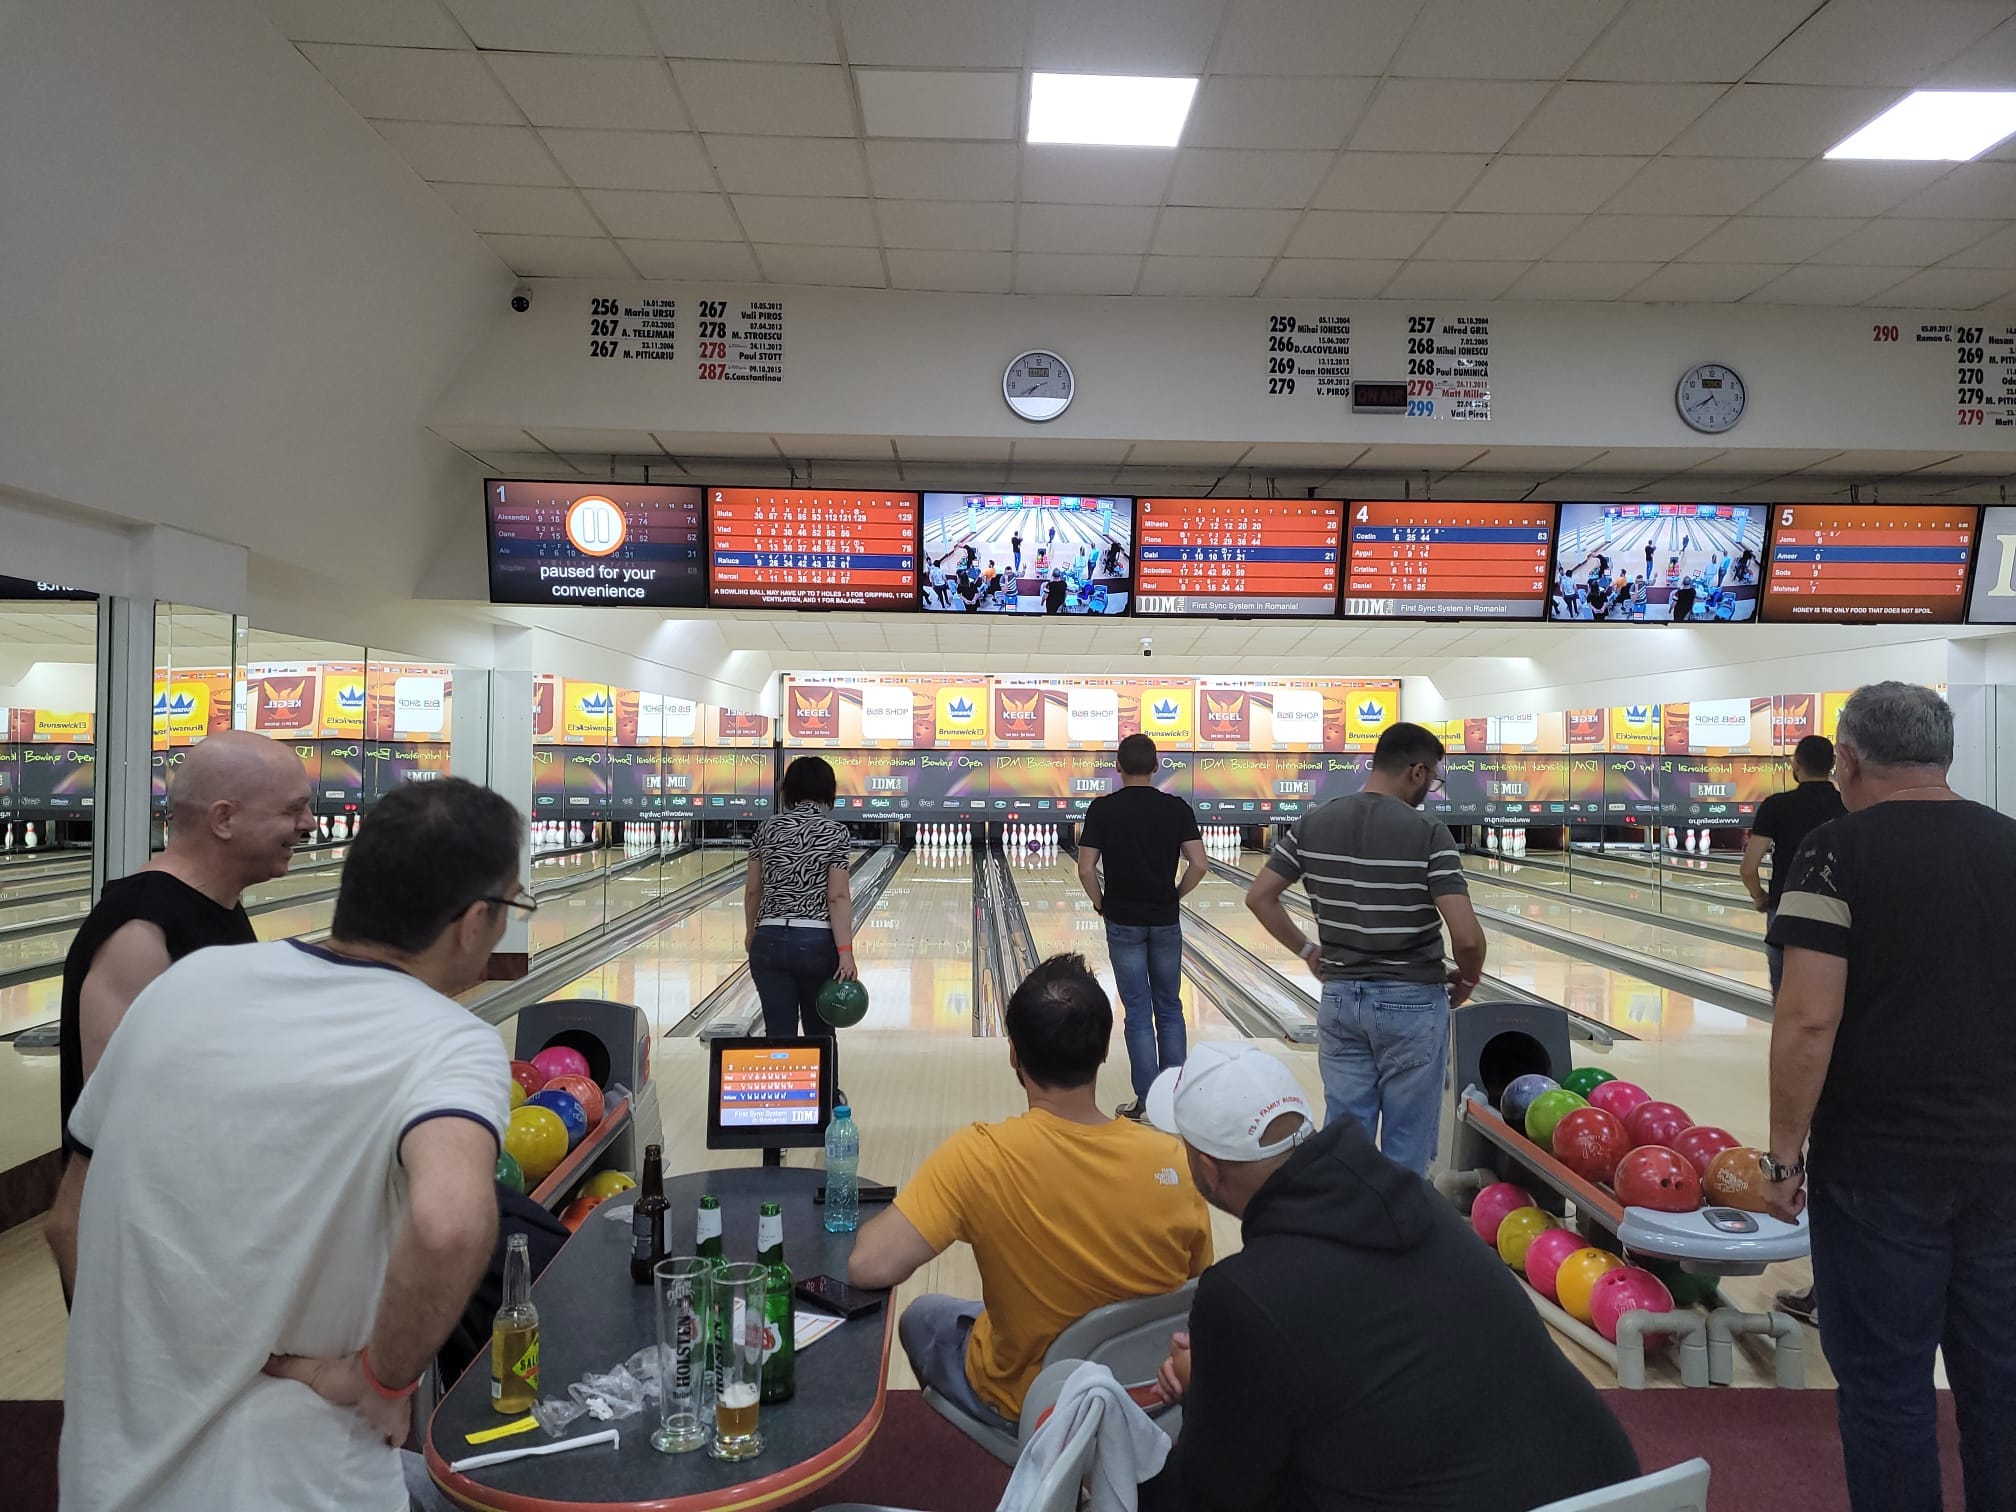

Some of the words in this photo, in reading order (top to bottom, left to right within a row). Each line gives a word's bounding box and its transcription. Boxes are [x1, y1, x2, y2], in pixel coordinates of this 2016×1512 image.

[592, 298, 618, 315] 256
[625, 308, 649, 317] Maria
[653, 309, 674, 318] URSU
[699, 301, 727, 318] 267
[741, 311, 756, 319] Vali
[591, 319, 618, 336] 267
[699, 322, 726, 338] 278
[1270, 316, 1295, 332] 259
[1297, 324, 1318, 334] Mihai
[1320, 325, 1349, 334] IONESCU
[1408, 317, 1435, 333] 257
[1442, 325, 1467, 335] Alfred
[1470, 326, 1488, 335] GRIL
[622, 329, 630, 337] A.
[633, 330, 674, 339] TELEJMAN
[732, 331, 741, 339] M.
[744, 331, 782, 340] STROESCU
[1873, 325, 1899, 341] 290
[1958, 327, 1983, 343] 267
[590, 340, 618, 357] 267
[699, 342, 726, 358] 278
[1269, 336, 1293, 352] 266
[1408, 338, 1434, 354] 268
[1436, 346, 1456, 355] Mihai
[1459, 347, 1487, 355] IONESCU
[624, 350, 633, 358] M.
[636, 350, 674, 360] PITICARIU
[739, 351, 756, 360] Paul
[759, 352, 782, 361] STOTT
[1958, 348, 1983, 363] 269
[1989, 356, 1998, 364] M.
[698, 363, 726, 380] 287
[1269, 358, 1294, 374] 269
[1298, 367, 1315, 375] Ioan
[1317, 367, 1349, 375] IONESCU
[1408, 359, 1434, 375] 268
[1436, 368, 1451, 376] Paul
[1958, 369, 1983, 384] 270
[1269, 378, 1295, 394] 279
[1408, 380, 1433, 396] 279
[1958, 389, 1983, 404] 279
[1408, 400, 1433, 416] 299
[1450, 410, 1466, 418] Vali
[1958, 410, 1984, 425] 279
[497, 486, 505, 502] 1
[715, 492, 722, 502] 2
[1144, 503, 1151, 512] 3
[1356, 505, 1368, 522] 4
[498, 513, 529, 521] Alexandru
[898, 513, 912, 521] 129
[1781, 509, 1793, 526] 5
[540, 565, 594, 579] paused
[598, 565, 619, 579] for
[623, 567, 656, 582] your
[1535, 565, 1544, 573] 16
[552, 584, 645, 598] convenience
[1140, 596, 1176, 613] IDM
[1212, 602, 1227, 611] Sync
[1229, 602, 1254, 611] System
[1349, 600, 1385, 615] IDM
[1417, 605, 1437, 613] Sync
[1439, 605, 1463, 613] System
[1474, 605, 1507, 613] Romania!
[796, 709, 831, 717] KEGEL
[885, 708, 908, 716] SHOP
[1003, 711, 1036, 719] KEGEL
[1090, 710, 1114, 718] SHOP
[1208, 712, 1242, 721] KEGEL
[38, 721, 78, 729] Brunswick
[66, 750, 94, 765] Open
[868, 756, 916, 766] International
[958, 756, 983, 770] Open
[996, 756, 1022, 768] IDM
[1161, 758, 1186, 770] Open
[1200, 758, 1225, 770] IDM
[1275, 758, 1322, 770] International
[872, 778, 896, 789] IDM
[1280, 781, 1302, 793] IDM
[862, 812, 911, 820] www.bowling.ro
[1259, 1098, 1280, 1117] FAMILY
[676, 1315, 691, 1388] HOLSTEN
